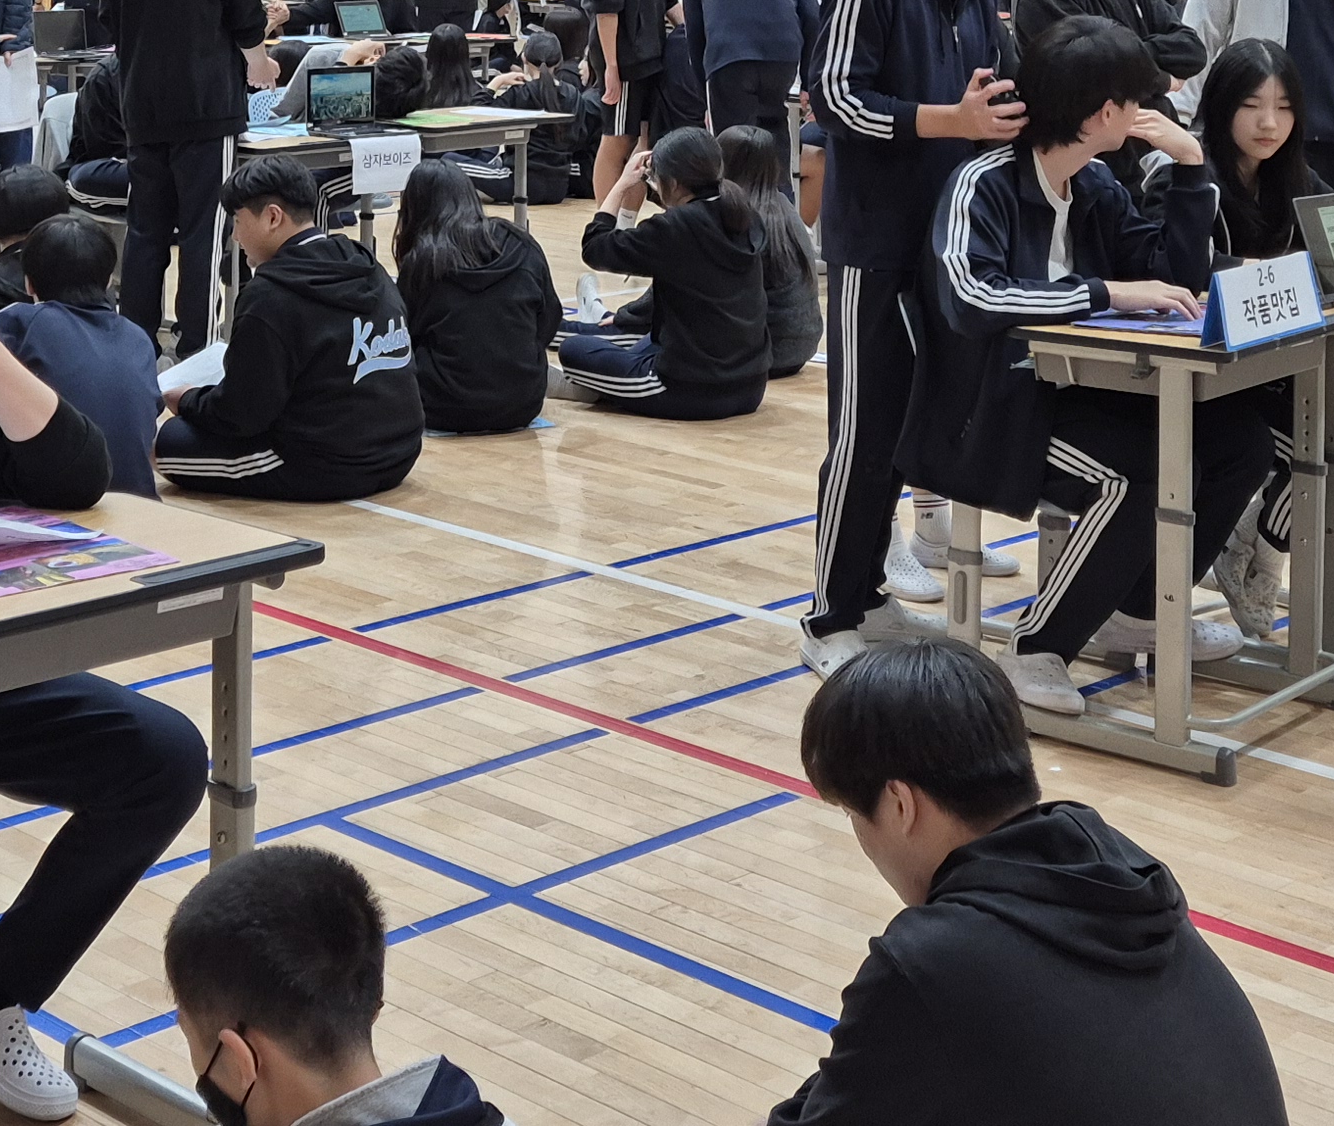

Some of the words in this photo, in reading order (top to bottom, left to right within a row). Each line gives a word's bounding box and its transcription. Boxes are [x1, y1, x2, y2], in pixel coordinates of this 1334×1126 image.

[362, 152, 412, 169] 삼자보이즈
[1256, 265, 1276, 287] 2-6
[1242, 286, 1301, 328] 작품맛집
